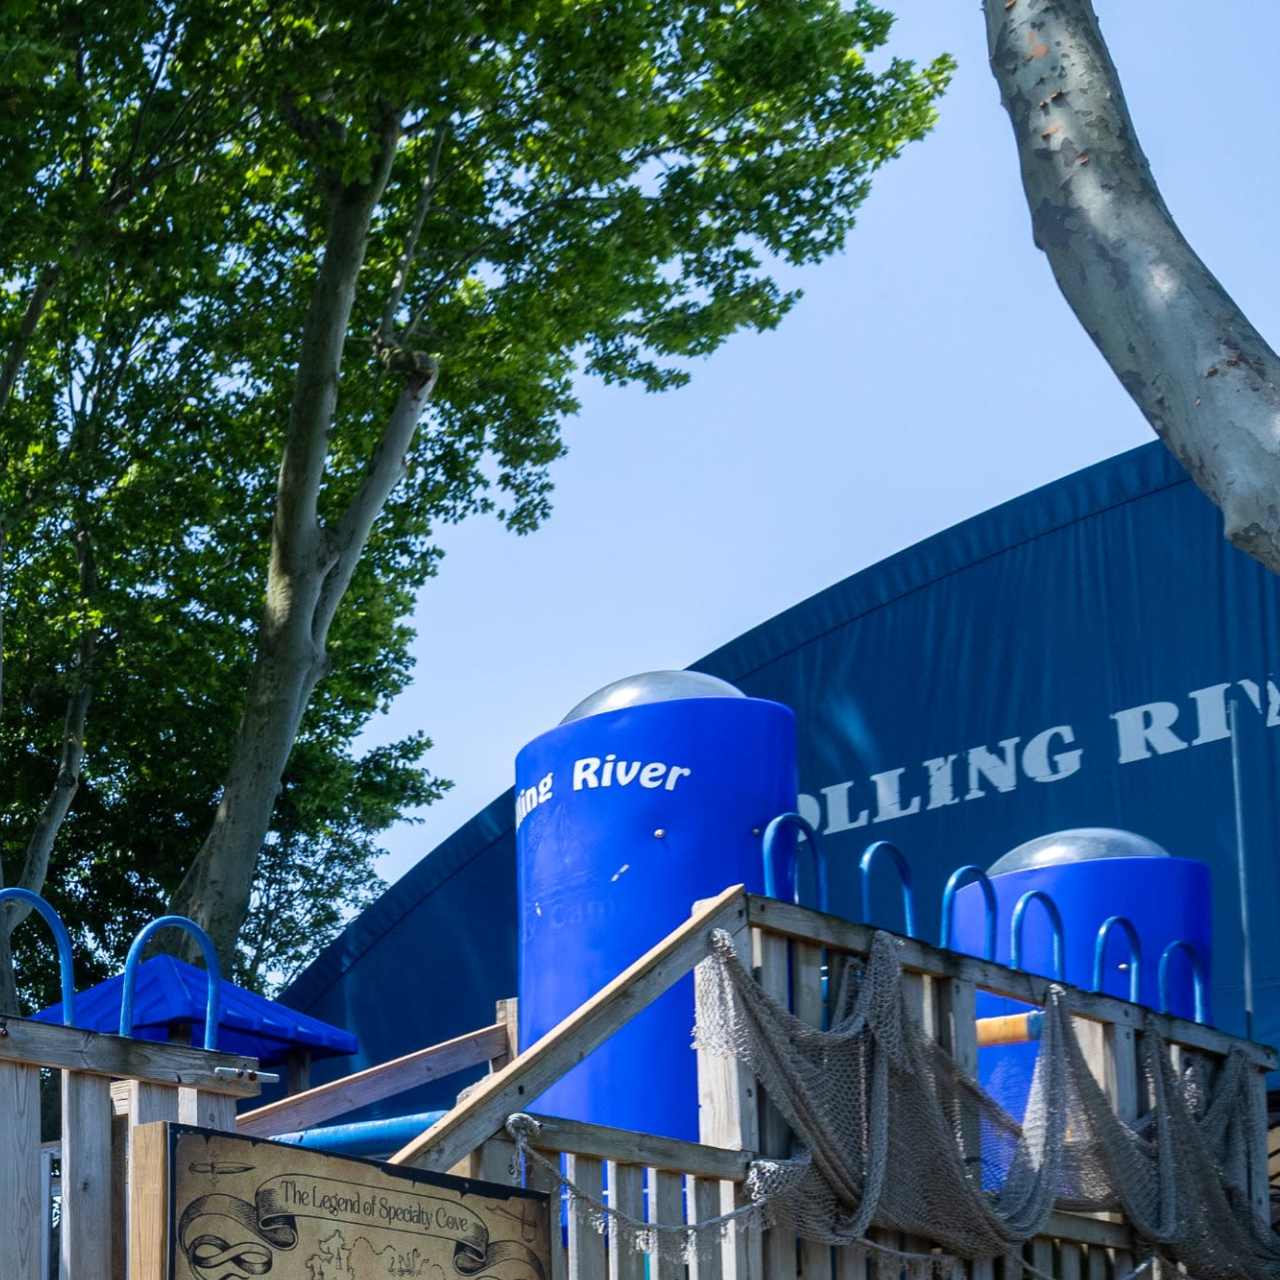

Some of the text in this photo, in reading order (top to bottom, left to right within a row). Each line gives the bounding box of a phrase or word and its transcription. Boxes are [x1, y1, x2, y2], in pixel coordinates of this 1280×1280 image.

[572, 754, 691, 791] River
[797, 725, 1083, 841] OLLING
[281, 1180, 467, 1231] The Legend of Specialty Cove
